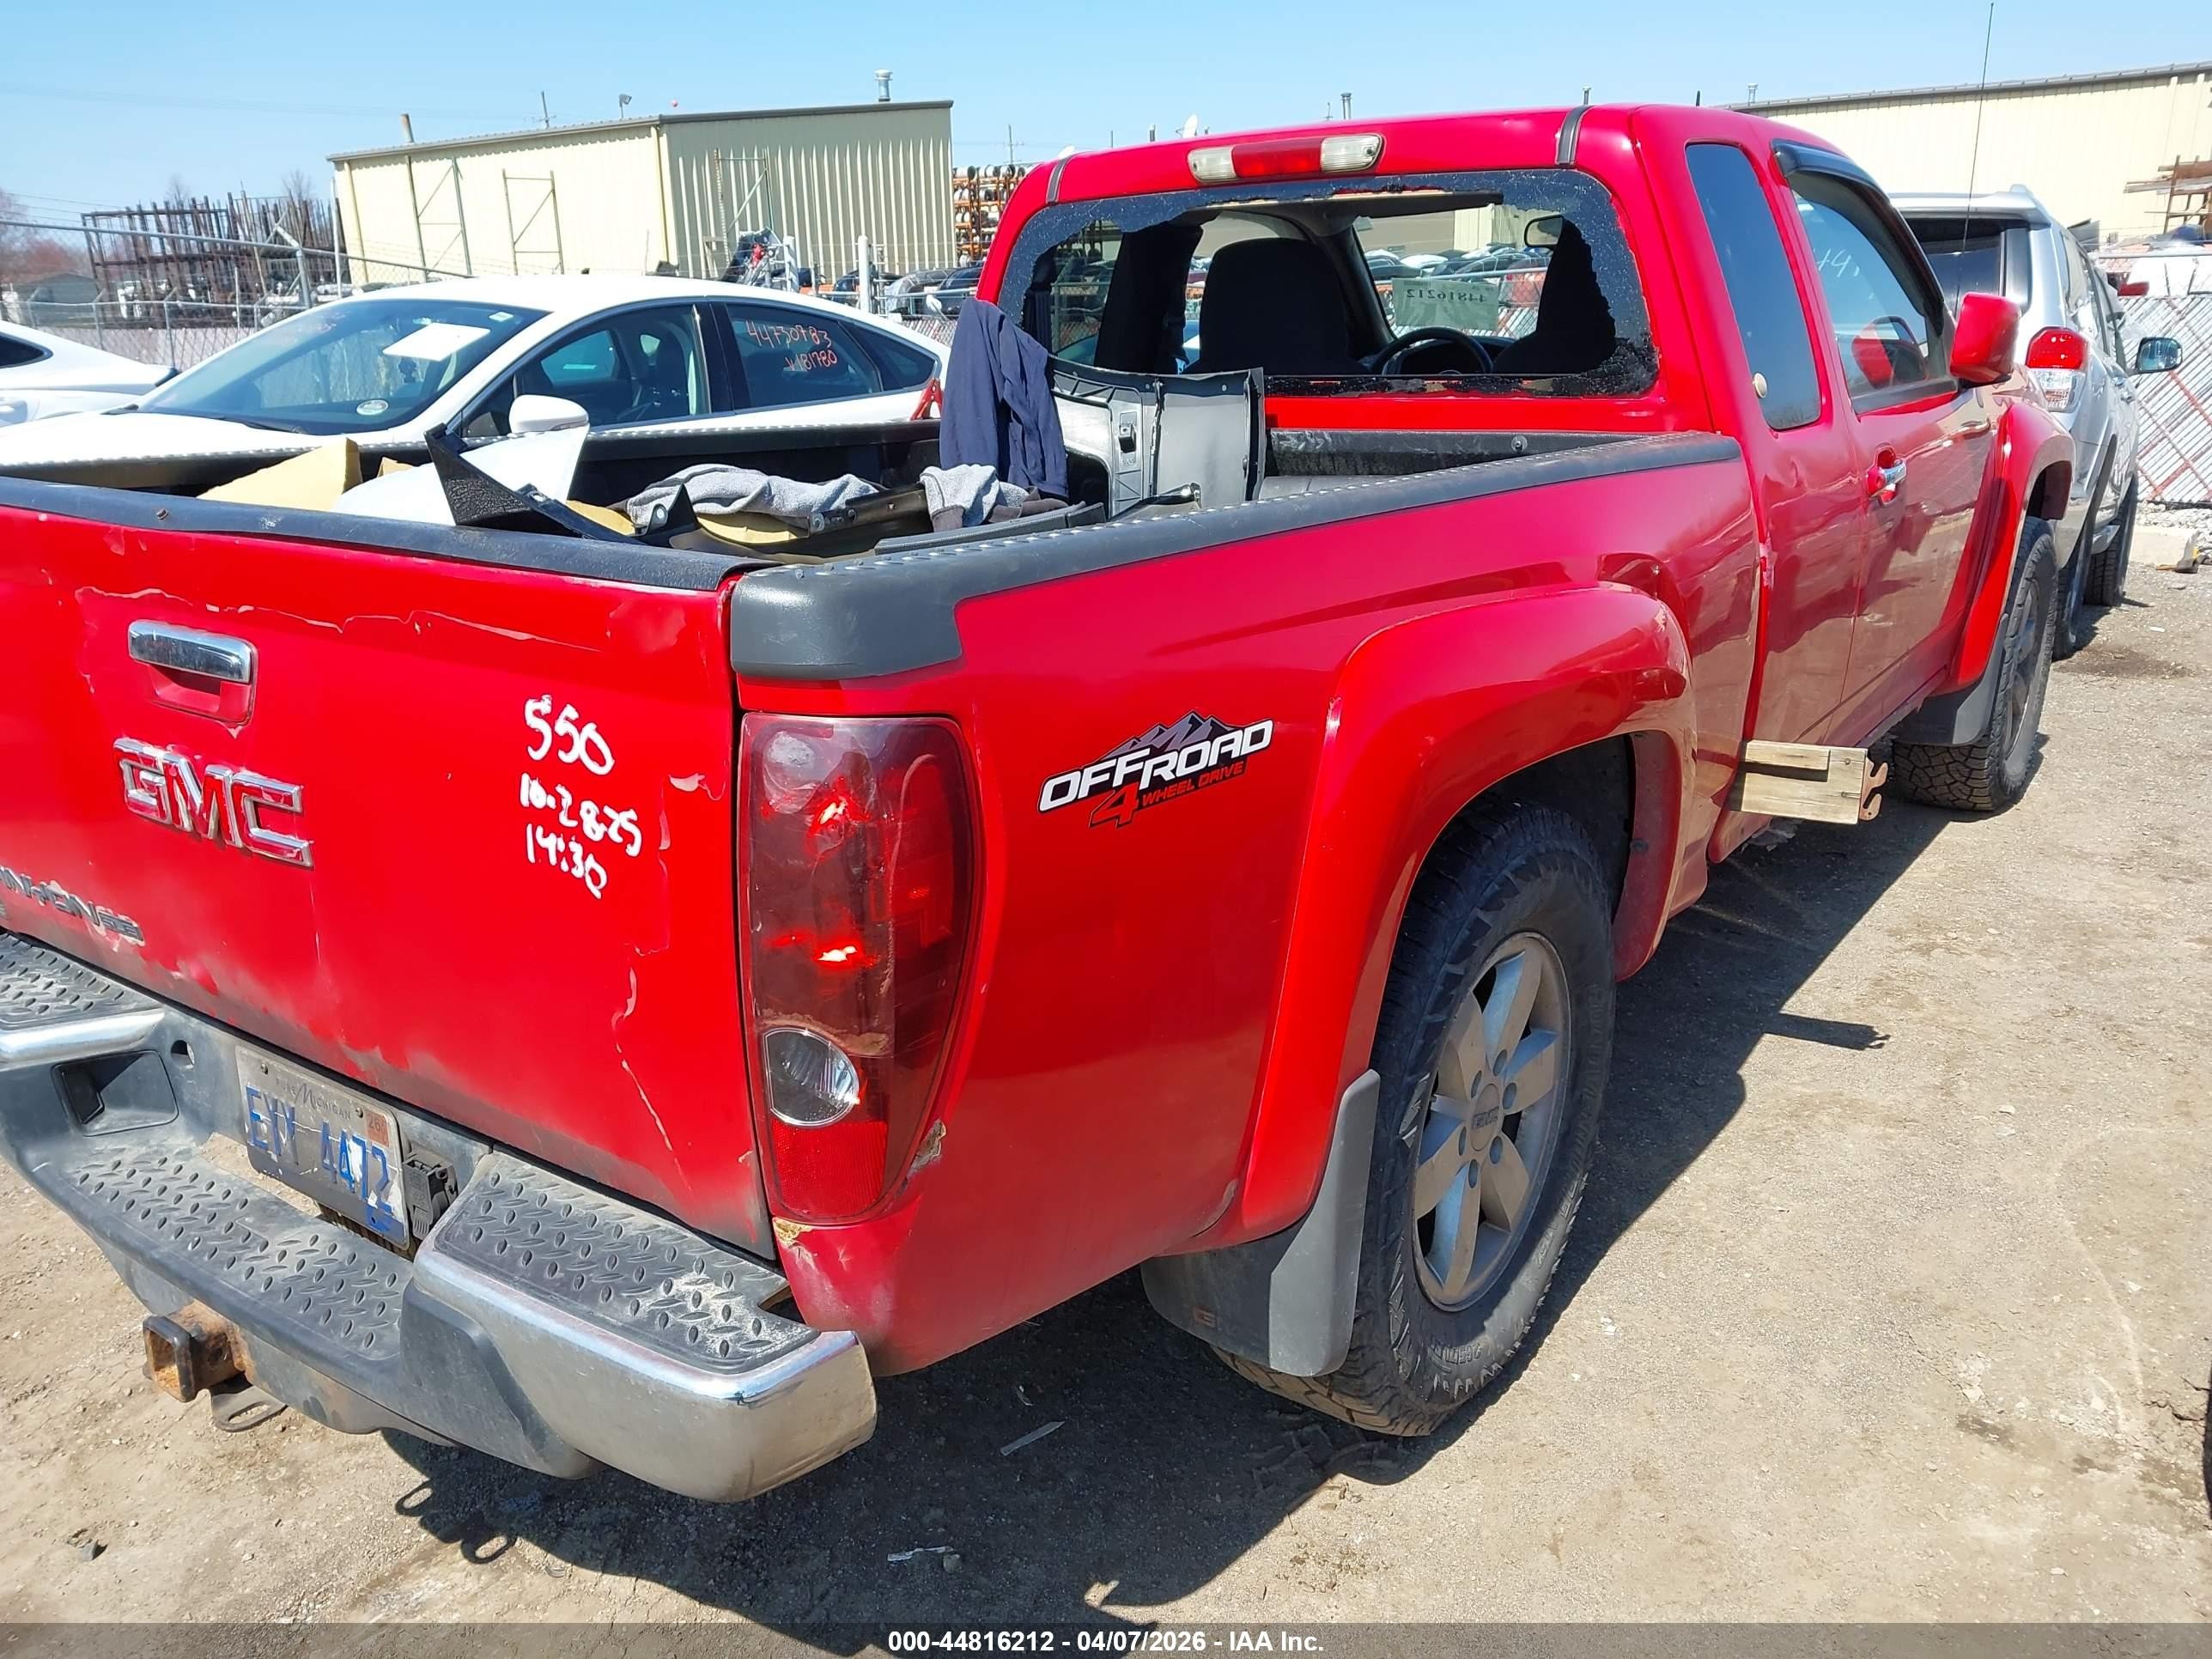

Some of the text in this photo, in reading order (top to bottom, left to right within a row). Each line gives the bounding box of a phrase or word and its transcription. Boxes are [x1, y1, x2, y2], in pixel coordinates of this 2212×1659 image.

[744, 319, 832, 349] 44730783
[525, 694, 615, 775] 550
[113, 735, 316, 869] GMC
[1090, 760, 1244, 825] 4 WHEEL DRIVE
[320, 1119, 393, 1217] 4472
